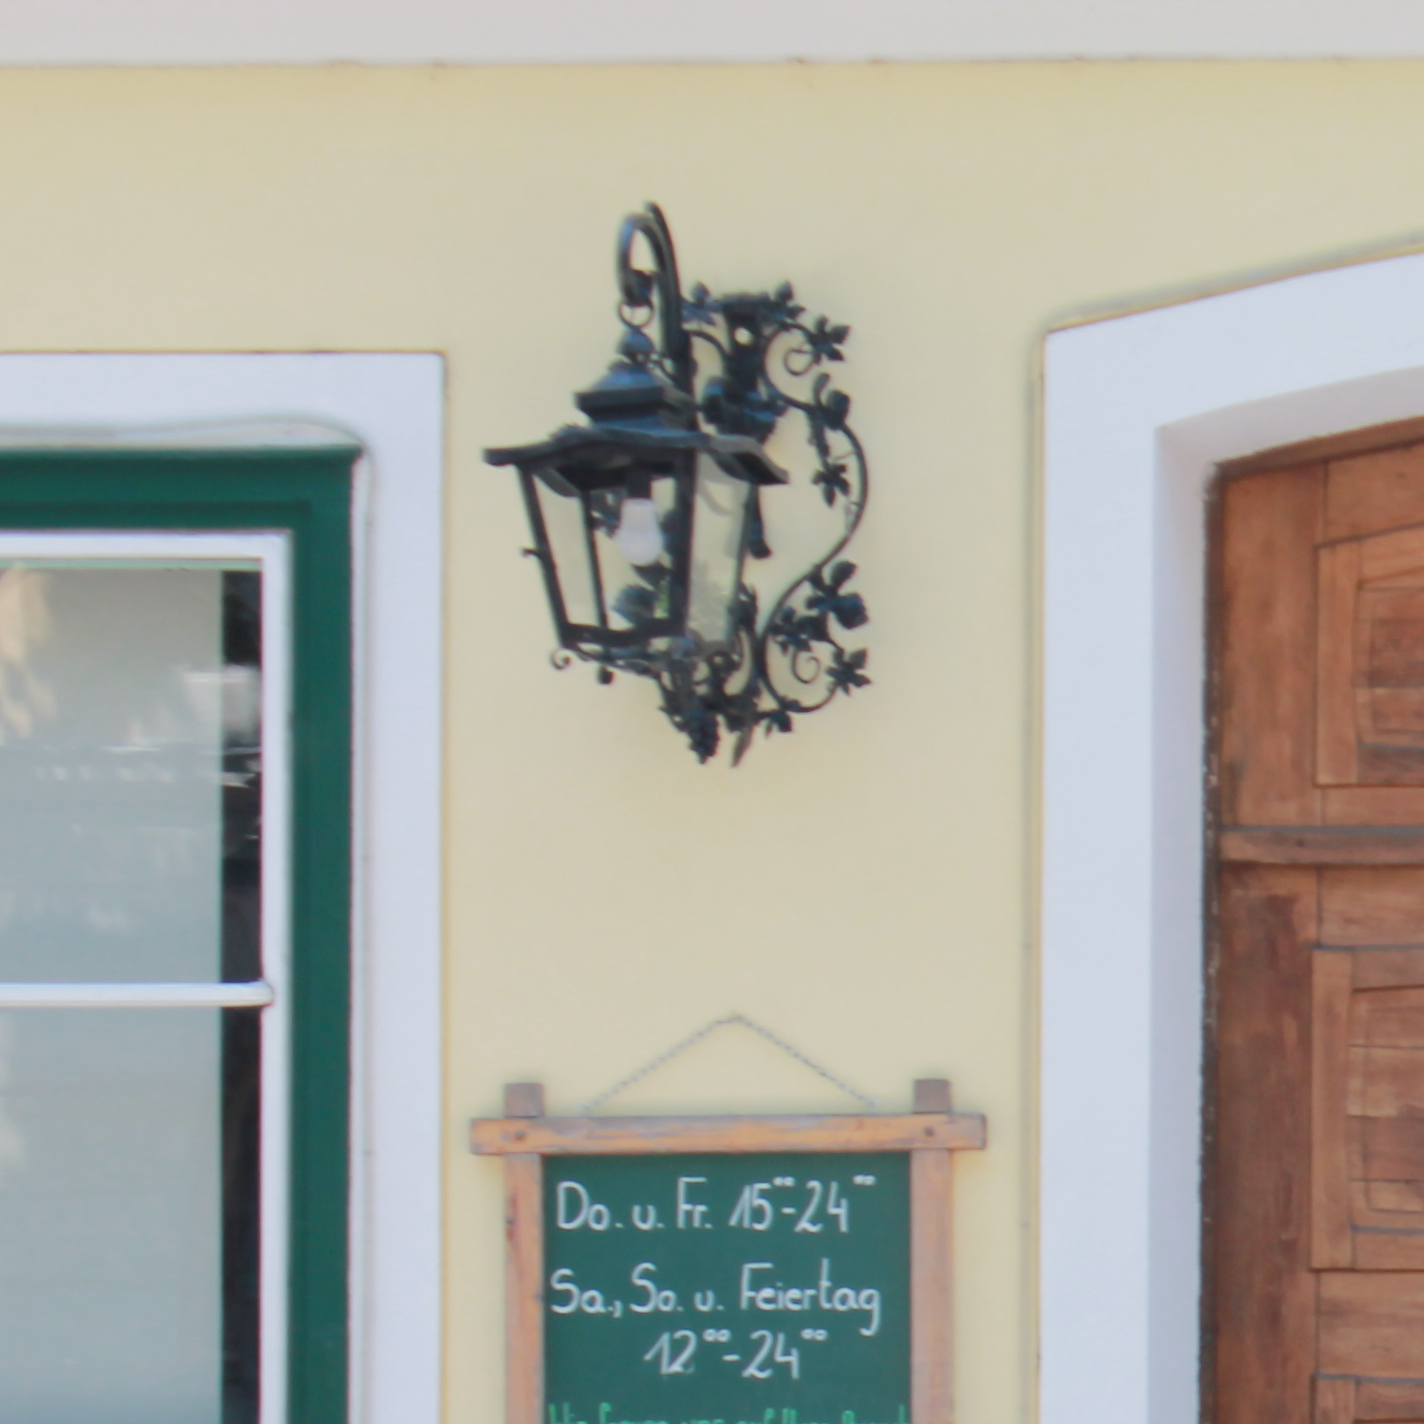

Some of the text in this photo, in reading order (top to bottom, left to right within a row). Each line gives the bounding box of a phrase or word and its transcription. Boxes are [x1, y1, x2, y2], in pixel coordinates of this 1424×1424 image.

[556, 1180, 624, 1231] Do.
[632, 1204, 665, 1231] u.
[677, 1176, 713, 1230] Fr.
[629, 1262, 684, 1313] So.
[694, 1289, 725, 1313] u.
[740, 1257, 881, 1336] Feiertag
